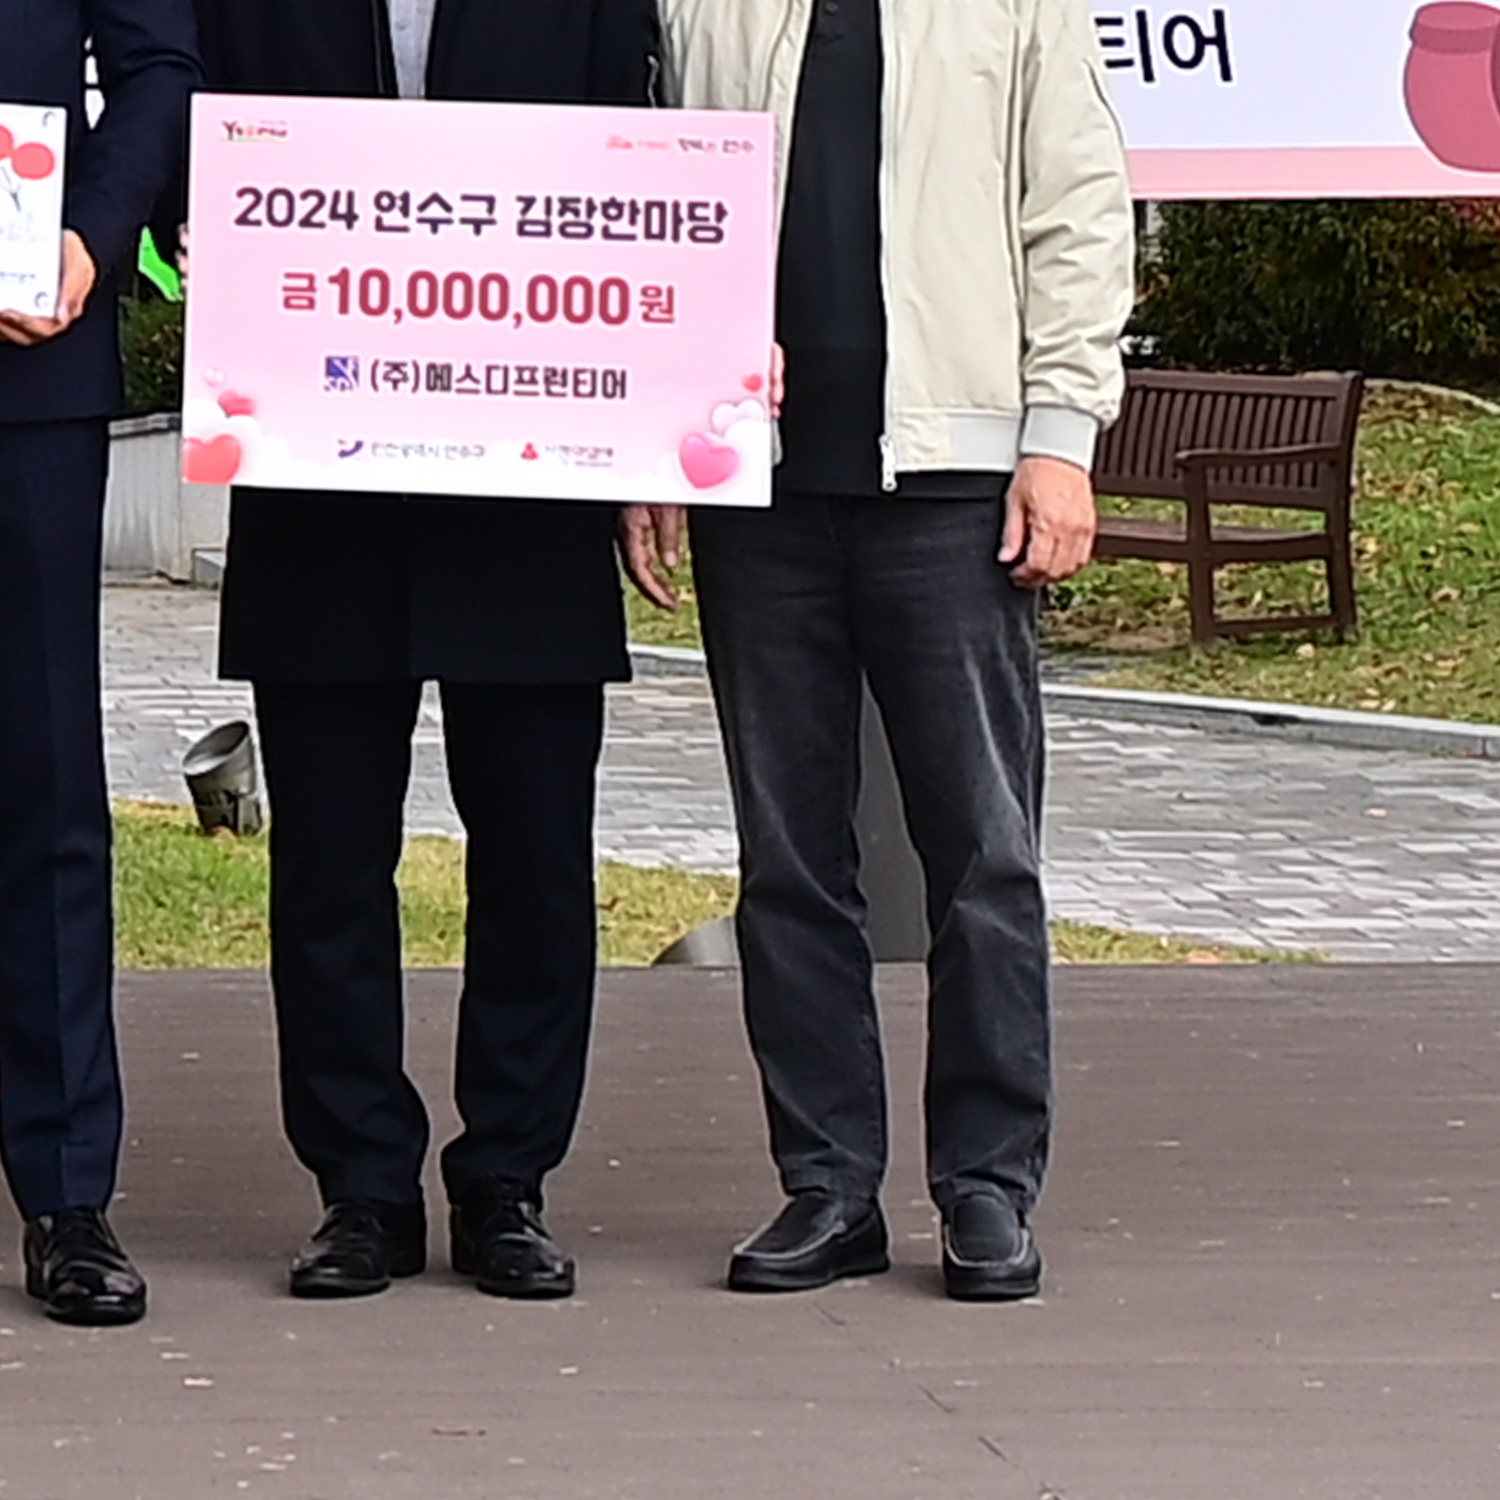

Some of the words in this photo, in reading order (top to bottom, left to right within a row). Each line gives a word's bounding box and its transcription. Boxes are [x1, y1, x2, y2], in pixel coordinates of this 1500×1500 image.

[233, 186, 359, 231] 2024
[373, 190, 497, 237] 연수구
[515, 195, 729, 246] 김장한마당
